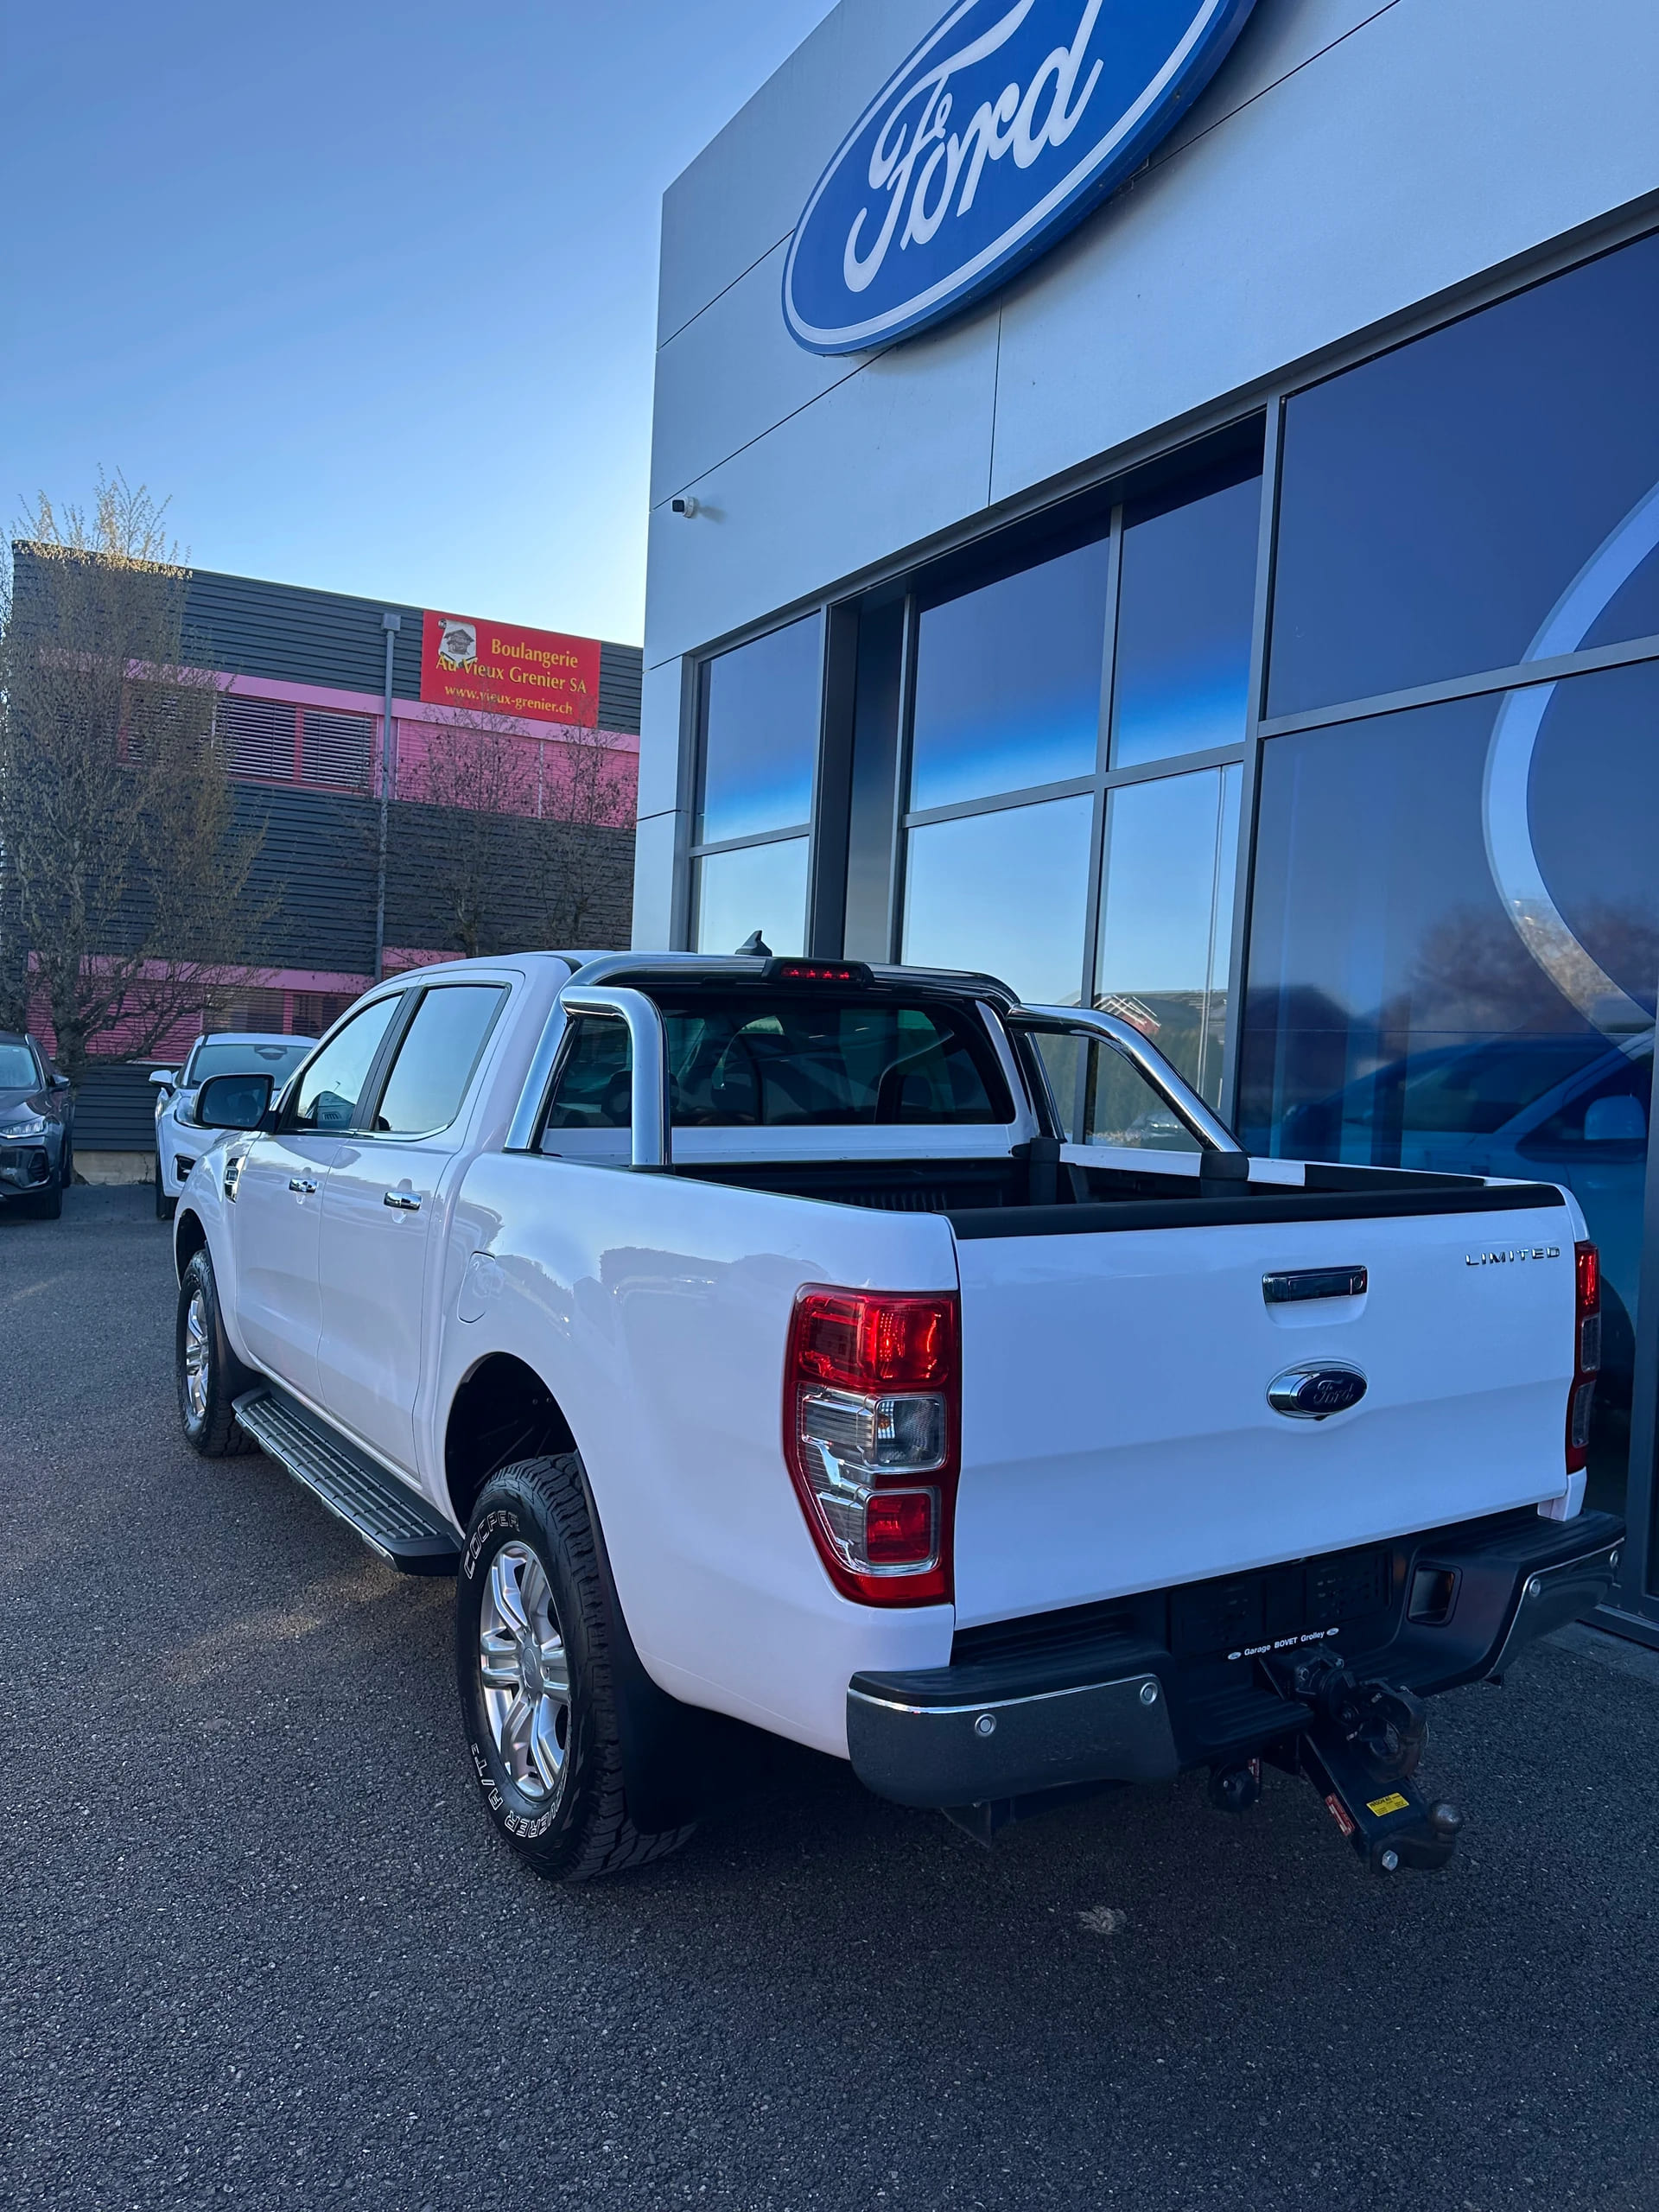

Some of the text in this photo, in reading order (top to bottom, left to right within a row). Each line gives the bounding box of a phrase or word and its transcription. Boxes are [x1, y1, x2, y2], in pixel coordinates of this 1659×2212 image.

[843, 0, 1104, 293] Ford
[491, 638, 579, 669] Boulangerie
[435, 655, 588, 694] Au Vieux Grenier SA
[444, 684, 574, 715] www.vieux-grenier.ch
[1465, 1246, 1560, 1266] LIMITED
[1313, 1380, 1353, 1405] Ford
[1244, 1644, 1272, 1656] Garage
[1274, 1637, 1299, 1649] BOVET
[1300, 1630, 1325, 1643] Grolley
